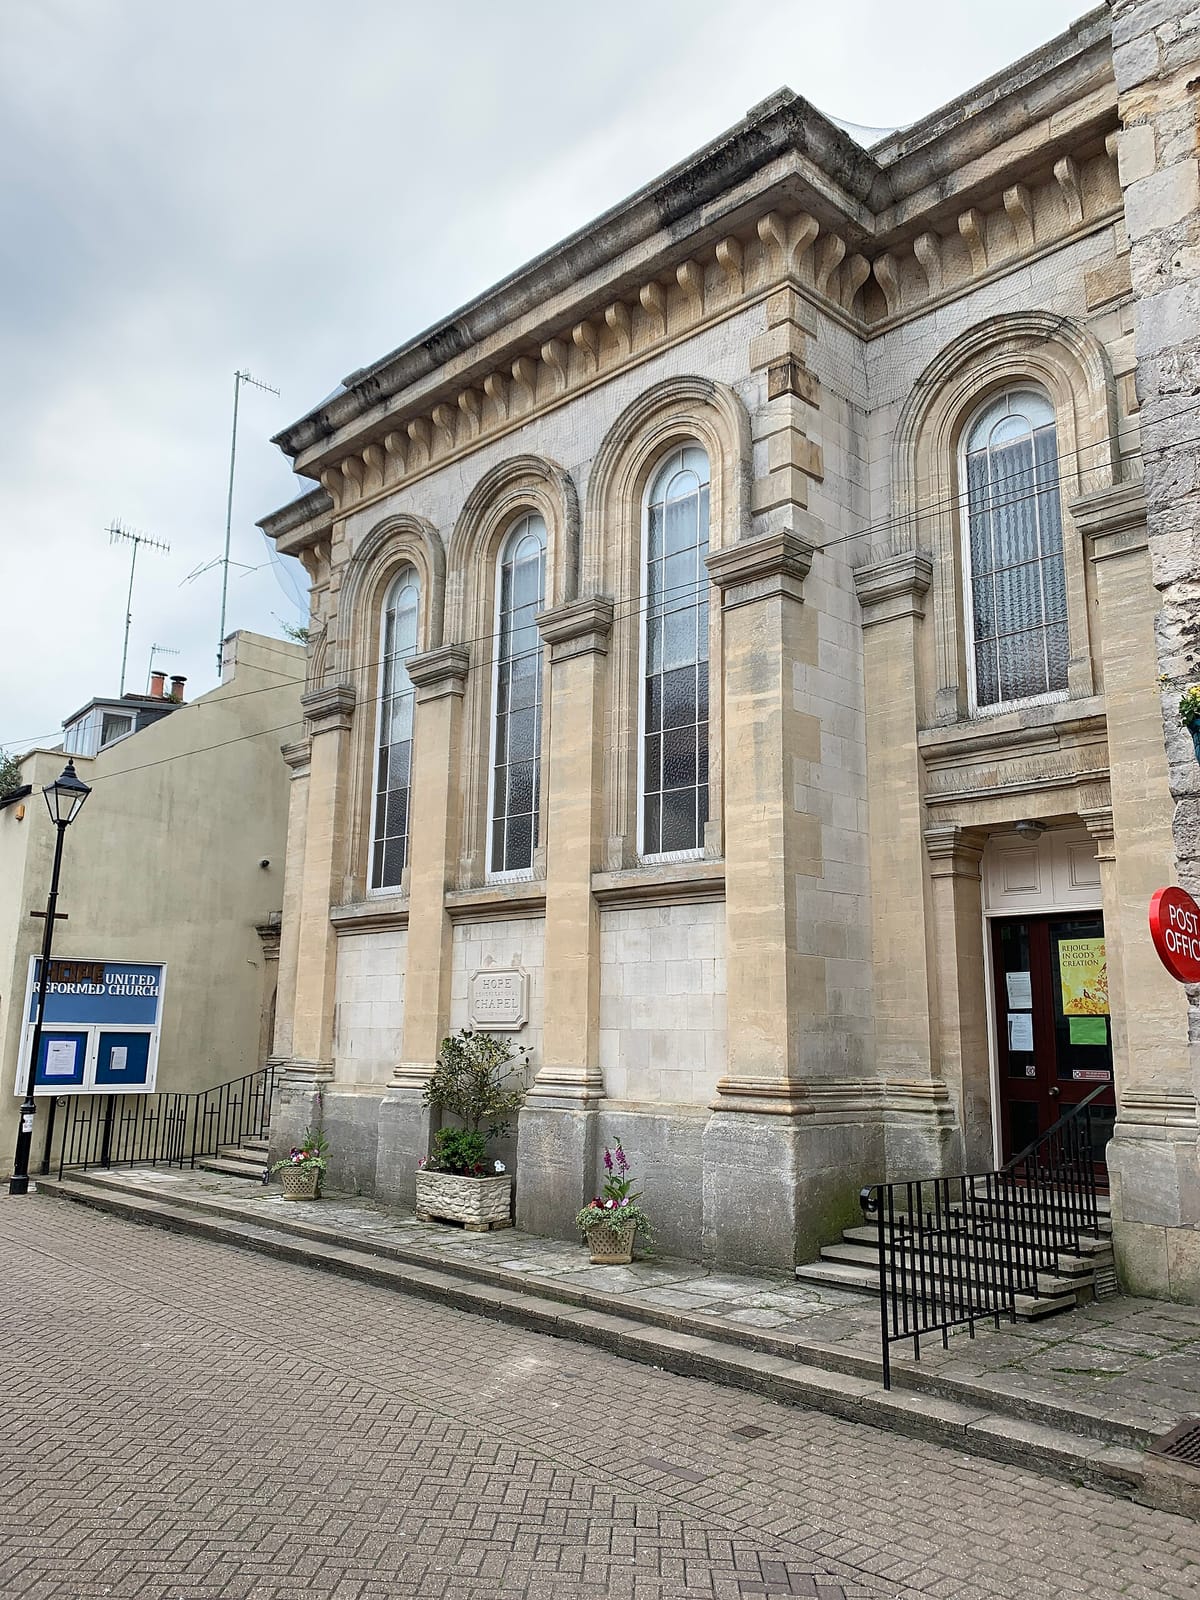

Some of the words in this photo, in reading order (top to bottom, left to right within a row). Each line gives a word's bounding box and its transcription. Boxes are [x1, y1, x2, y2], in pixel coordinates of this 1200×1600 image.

[1168, 903, 1198, 936] POST
[1061, 944, 1090, 952] REJOICE
[1165, 928, 1200, 962] OFFIC
[1062, 952, 1071, 960] IN
[1072, 951, 1095, 960] GOD'S
[1062, 959, 1099, 967] CREATION
[105, 973, 156, 986] UNITED
[482, 978, 512, 990] HOPE
[32, 982, 106, 995] REFORMED
[108, 983, 159, 997] CHURCH
[475, 998, 519, 1009] CHAPEL
